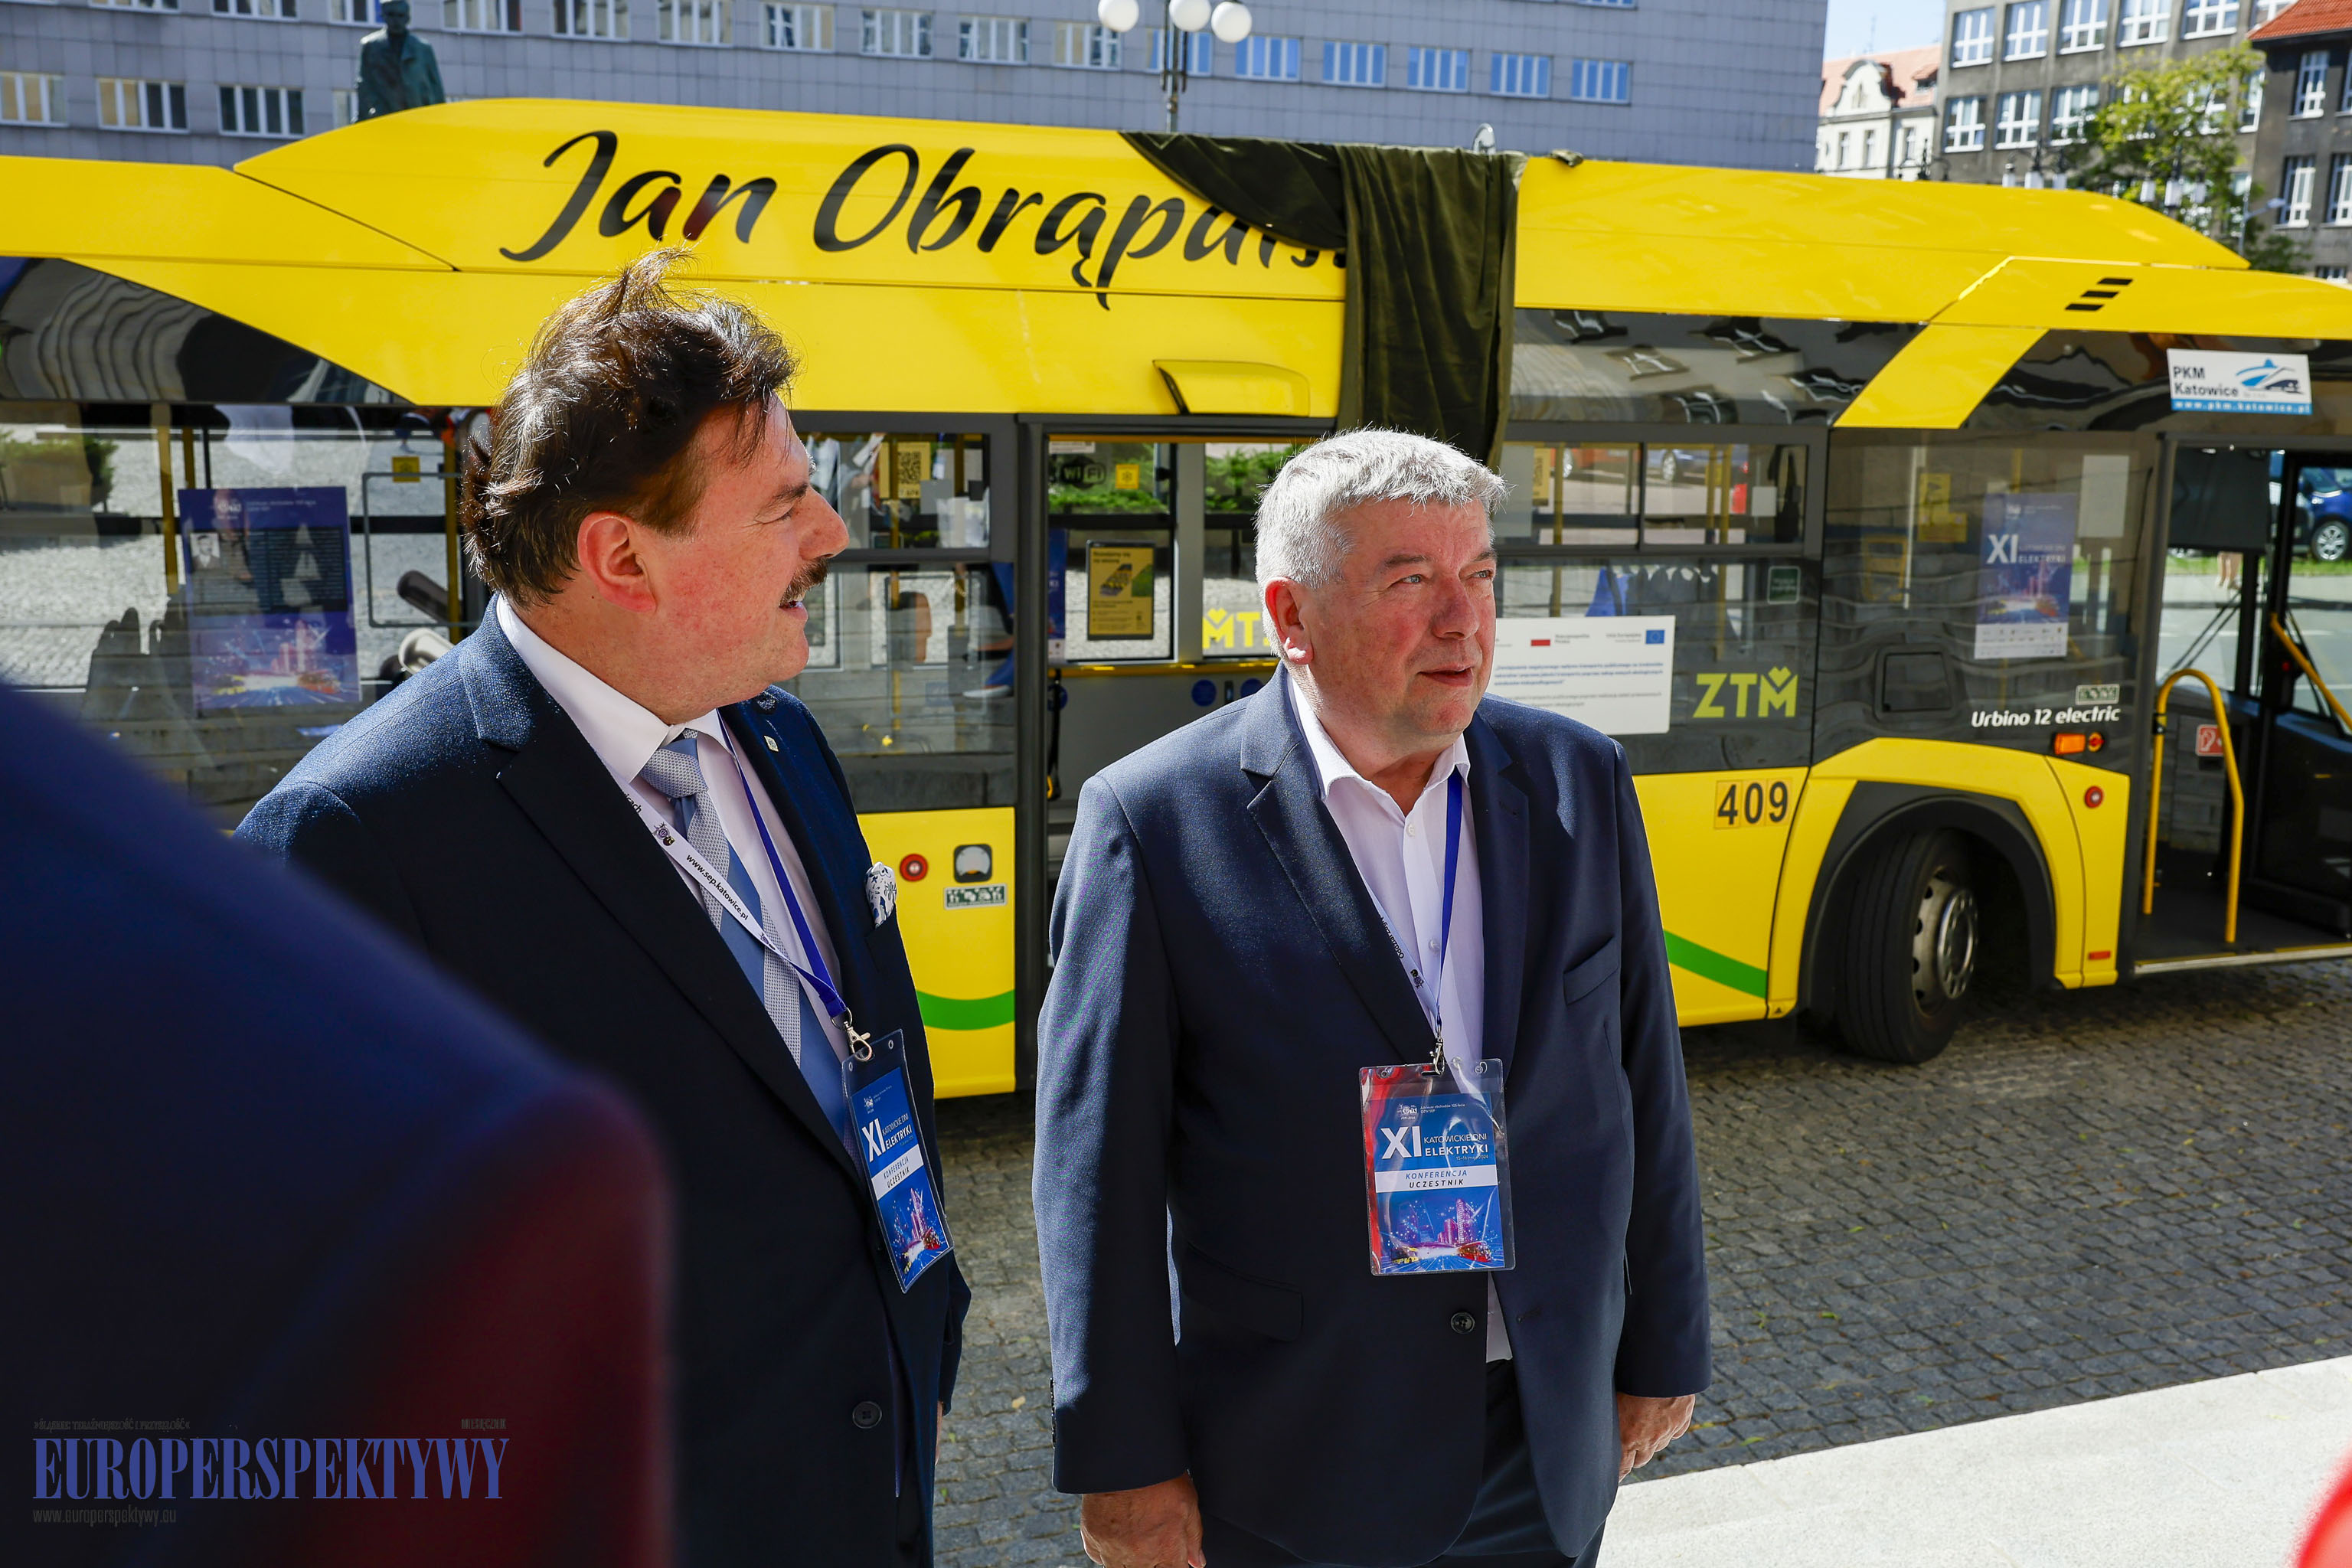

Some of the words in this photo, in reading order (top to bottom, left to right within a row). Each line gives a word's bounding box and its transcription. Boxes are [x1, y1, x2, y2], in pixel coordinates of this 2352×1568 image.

[499, 130, 776, 261] Jan
[2173, 366, 2205, 379] PKM
[2174, 383, 2238, 397] Katowice
[2174, 400, 2310, 413] www.pkm.katowice.pl
[1986, 534, 2019, 564] XI
[1694, 667, 1798, 717] ZTM
[1971, 710, 2030, 727] Urbino
[2034, 708, 2053, 725] 12
[2055, 705, 2121, 724] electric
[1717, 782, 1788, 825] 409
[686, 854, 749, 921] www.sep.katowice.pl
[861, 1118, 886, 1162] XI
[885, 1124, 913, 1150] ELEKTRYKI
[1380, 1125, 1423, 1159] XI
[1424, 1134, 1470, 1144] KATOWICKIE
[1425, 1144, 1488, 1157] ELEKTRYKI
[884, 1155, 909, 1179] KONFERENCJA
[887, 1166, 910, 1188] UCZESTNIK
[1406, 1170, 1468, 1180] KONFERENCJA
[1409, 1179, 1464, 1188] UCZESTNIK
